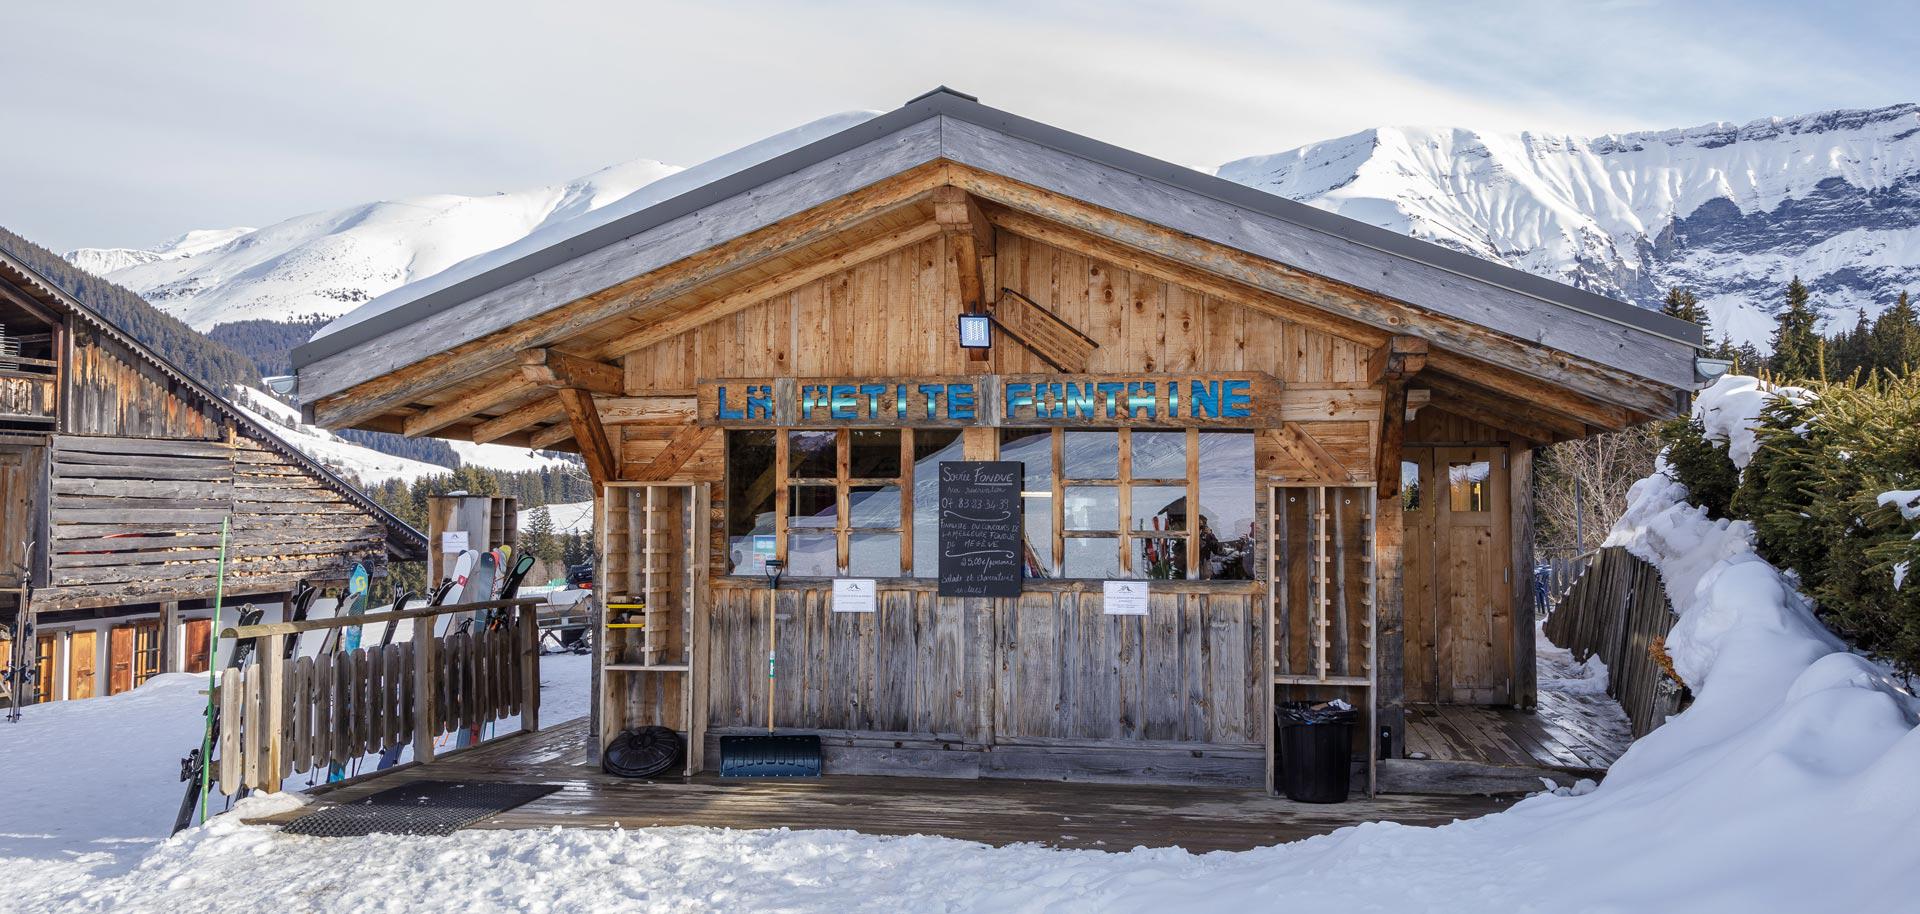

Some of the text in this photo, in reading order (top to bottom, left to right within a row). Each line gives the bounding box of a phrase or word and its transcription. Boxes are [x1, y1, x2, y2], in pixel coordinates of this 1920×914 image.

[718, 380, 1251, 420] LA PETITE FONTAINE
